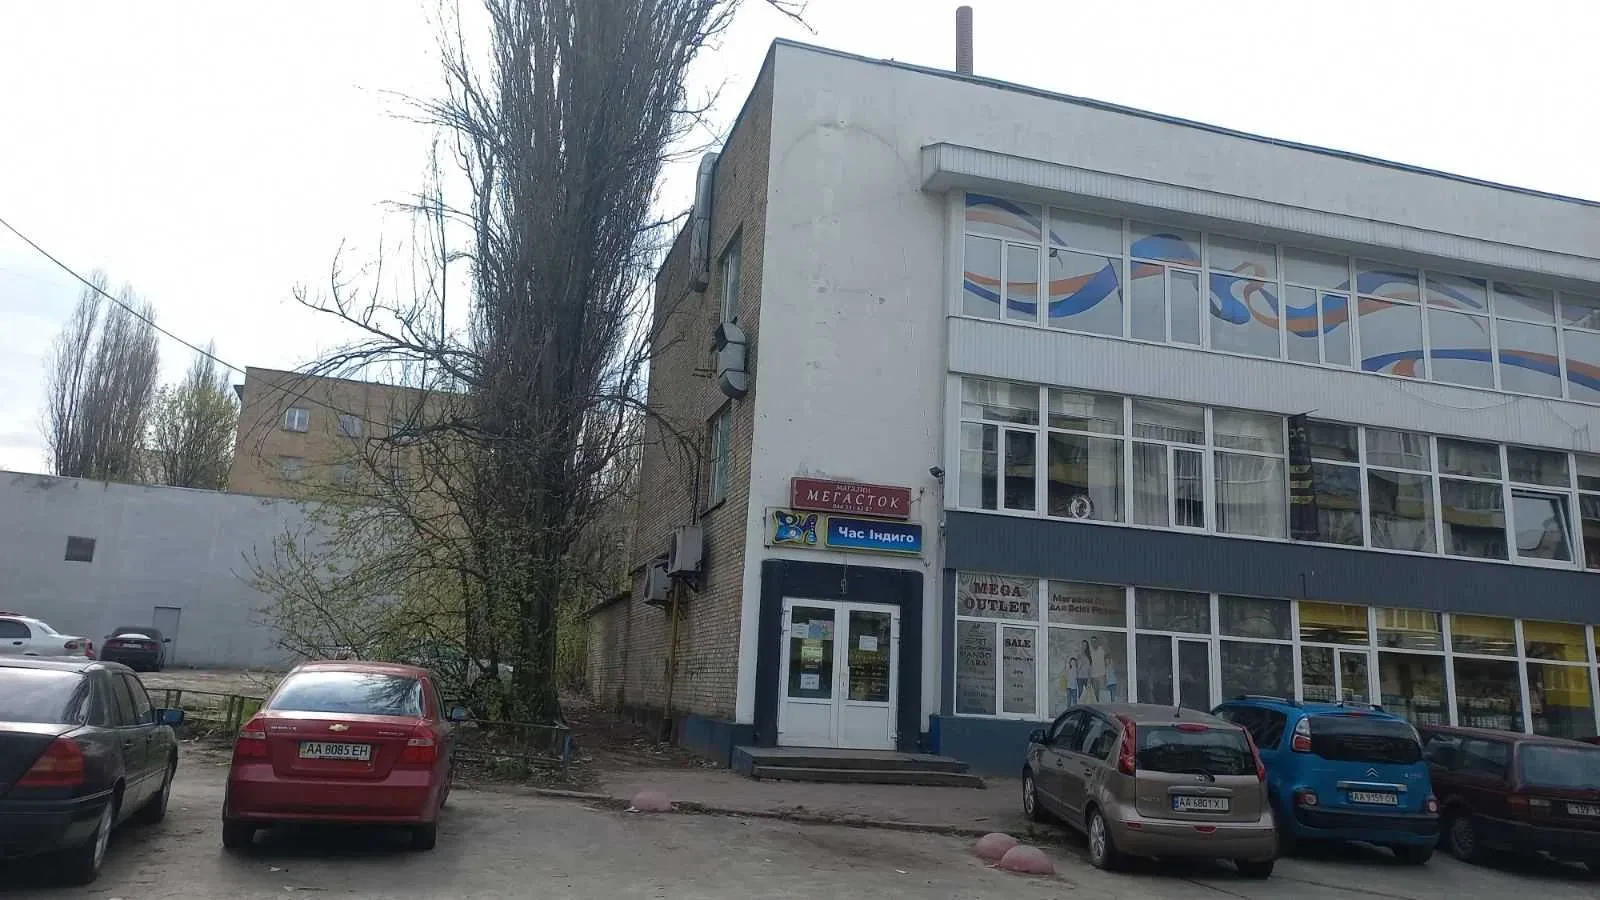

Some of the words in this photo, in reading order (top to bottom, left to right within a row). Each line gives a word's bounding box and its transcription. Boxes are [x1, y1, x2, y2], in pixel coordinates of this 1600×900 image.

[807, 489, 901, 509] МЕГАСТОК
[837, 526, 865, 539] Час
[869, 529, 915, 544] Індиго
[973, 582, 1023, 597] MEGA
[965, 597, 1031, 614] OUTLET
[1004, 638, 1032, 648] SALE
[307, 743, 322, 755] AA
[325, 744, 350, 756] 8085
[352, 745, 368, 757] EH
